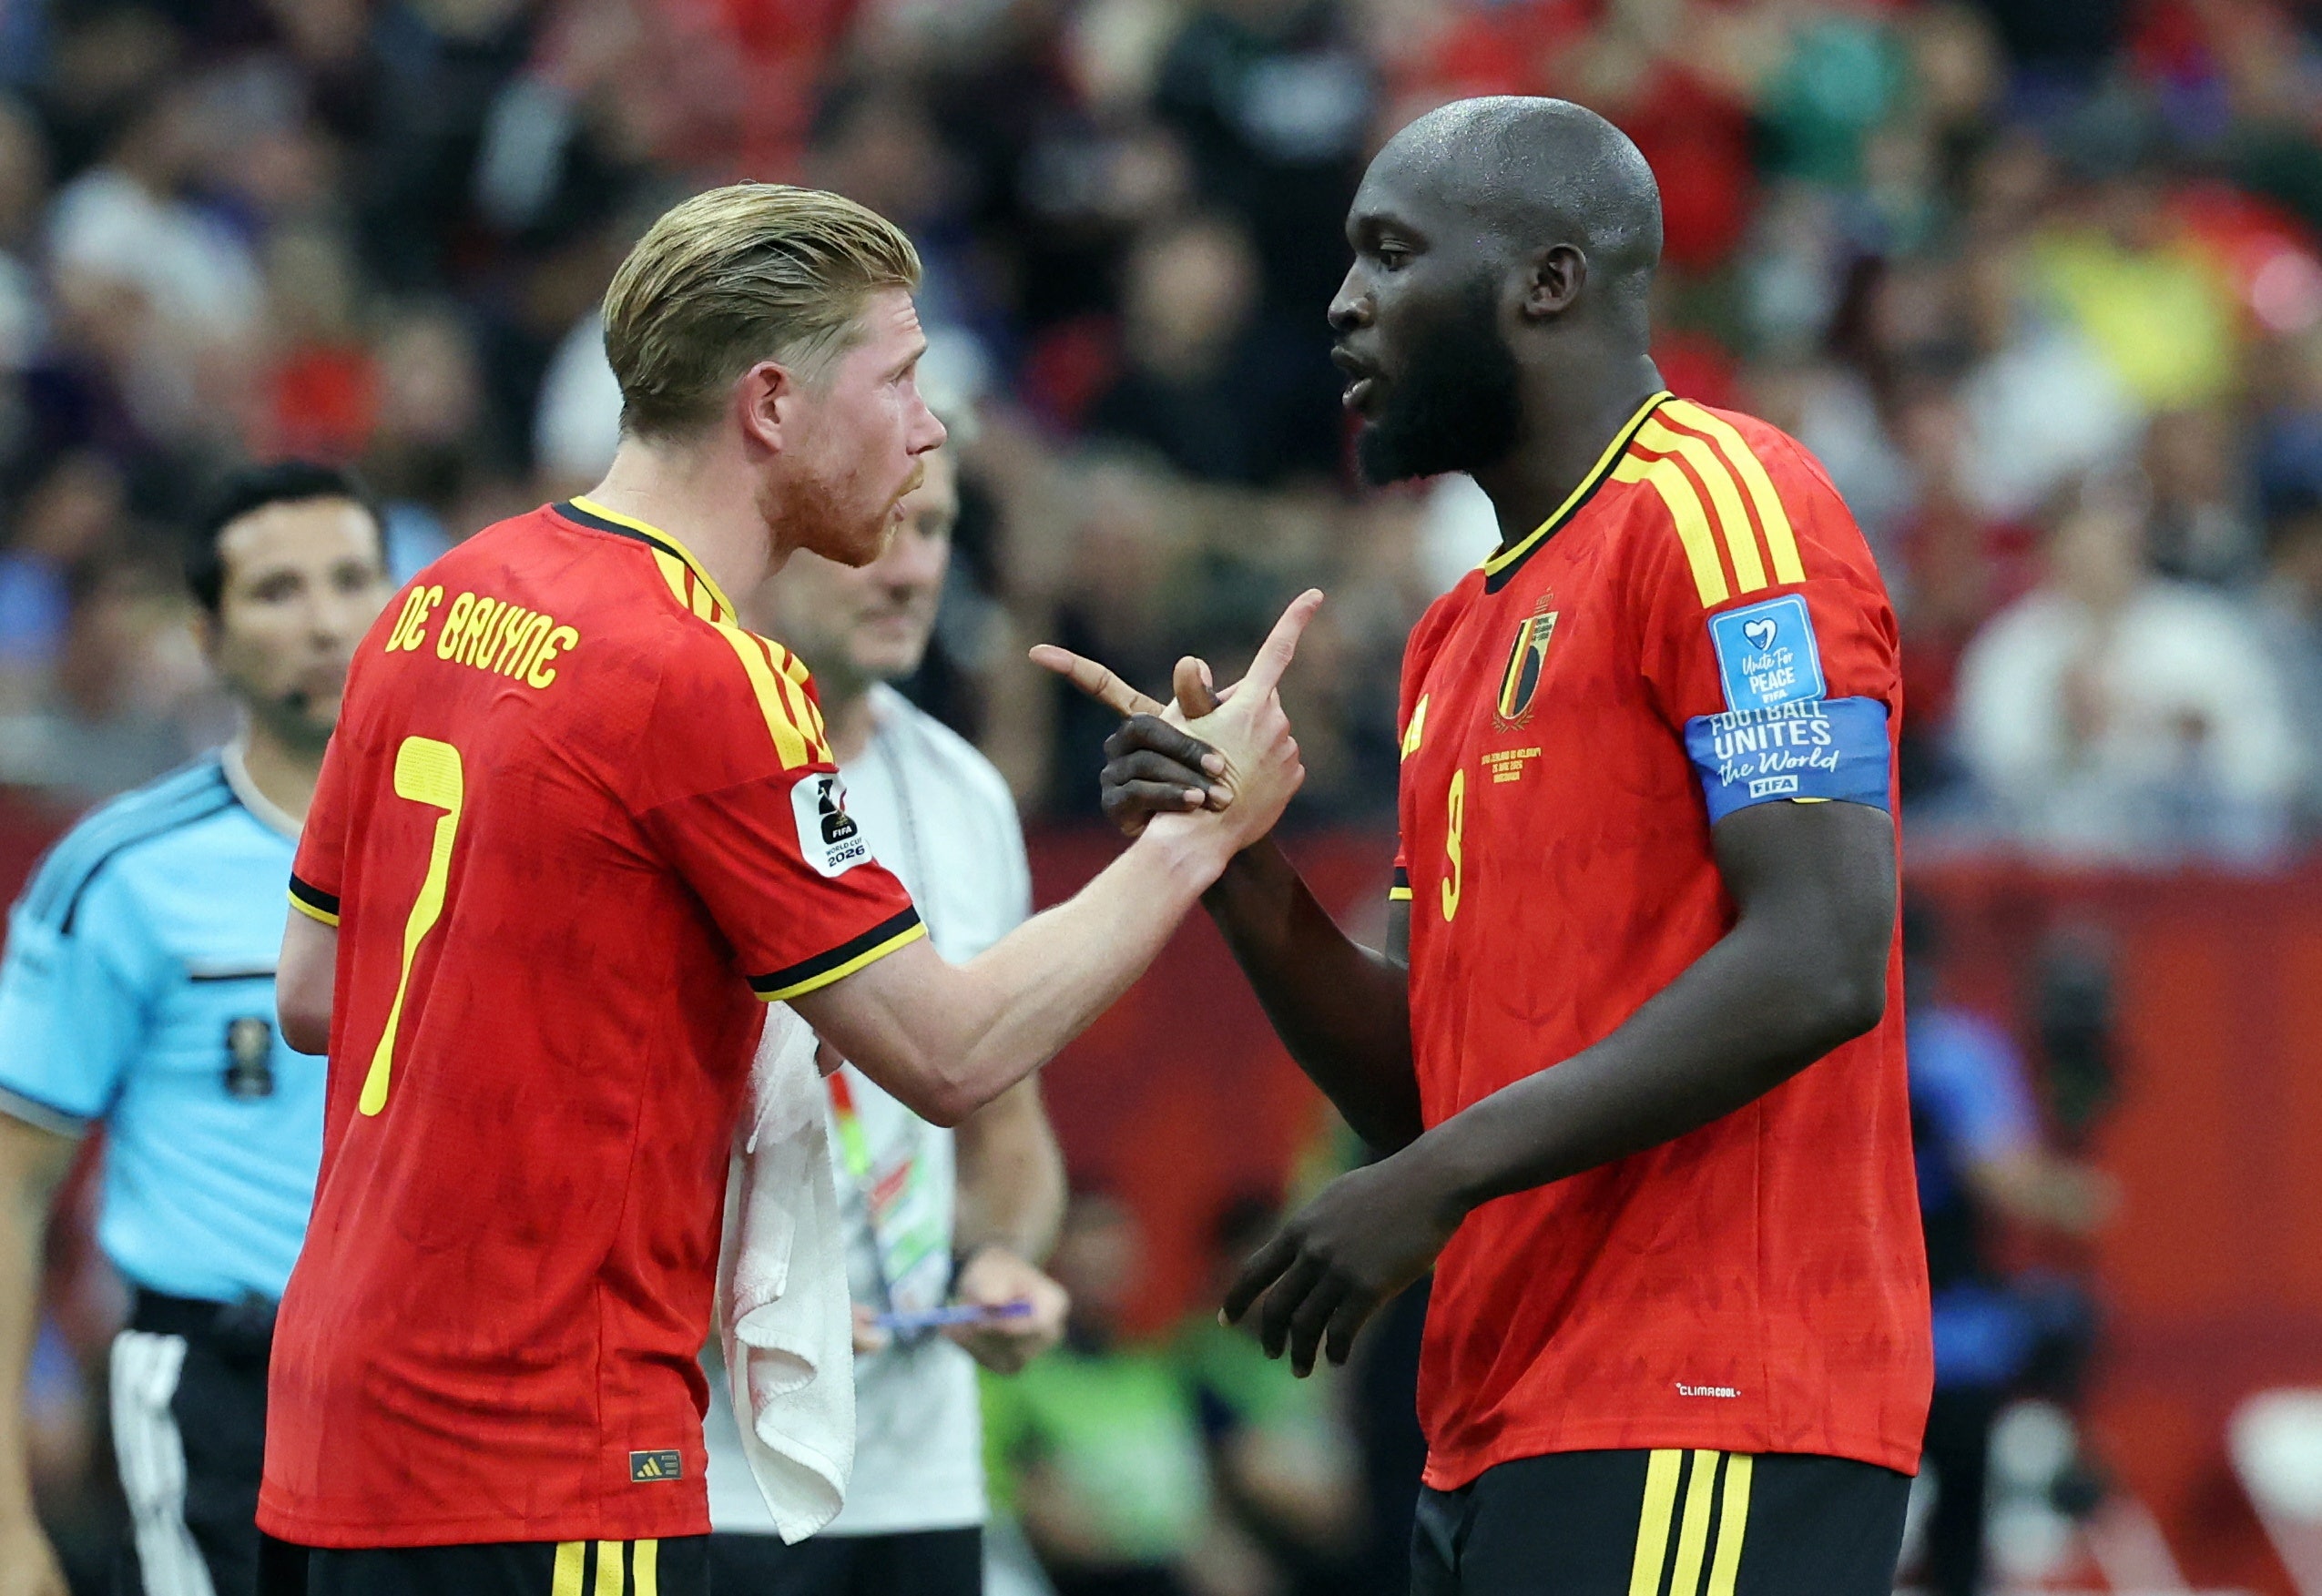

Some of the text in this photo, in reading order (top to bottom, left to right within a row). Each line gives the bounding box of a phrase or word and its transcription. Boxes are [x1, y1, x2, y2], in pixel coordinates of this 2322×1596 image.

[384, 585, 579, 689] DE BRUYNE
[1743, 647, 1794, 676] Unite For
[1749, 666, 1796, 694] PEACE
[1762, 689, 1788, 704] FIFA
[1710, 700, 1828, 737] FOOTBALL
[1714, 719, 1831, 760] UNITES
[1716, 747, 1839, 788] the World
[1752, 778, 1795, 795] FIFA
[832, 826, 852, 838] FIFA
[1442, 768, 1465, 922] 9
[826, 842, 849, 855] WORLD
[828, 845, 865, 868] 2026
[359, 736, 463, 1117] 7
